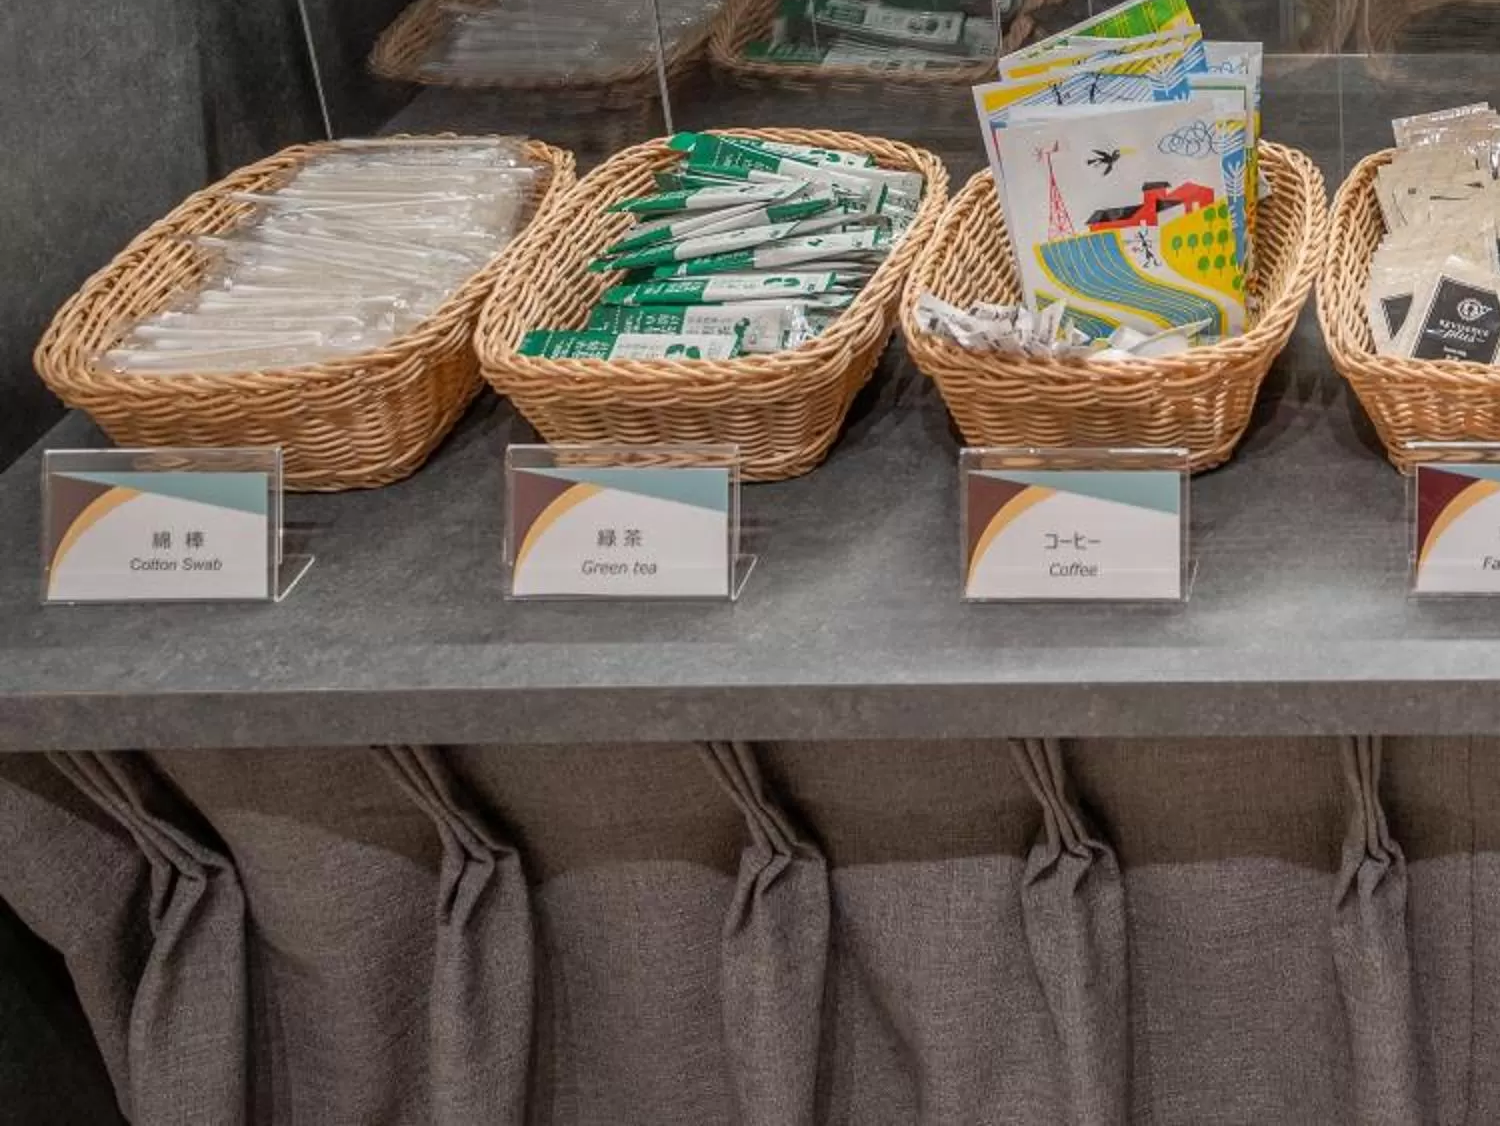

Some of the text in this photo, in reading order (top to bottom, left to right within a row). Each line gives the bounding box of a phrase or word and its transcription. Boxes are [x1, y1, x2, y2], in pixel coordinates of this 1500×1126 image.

[1044, 531, 1102, 550] コーヒー
[129, 557, 223, 572] Cotton Swab
[581, 560, 658, 576] Green tea
[1049, 561, 1099, 578] Coffee
